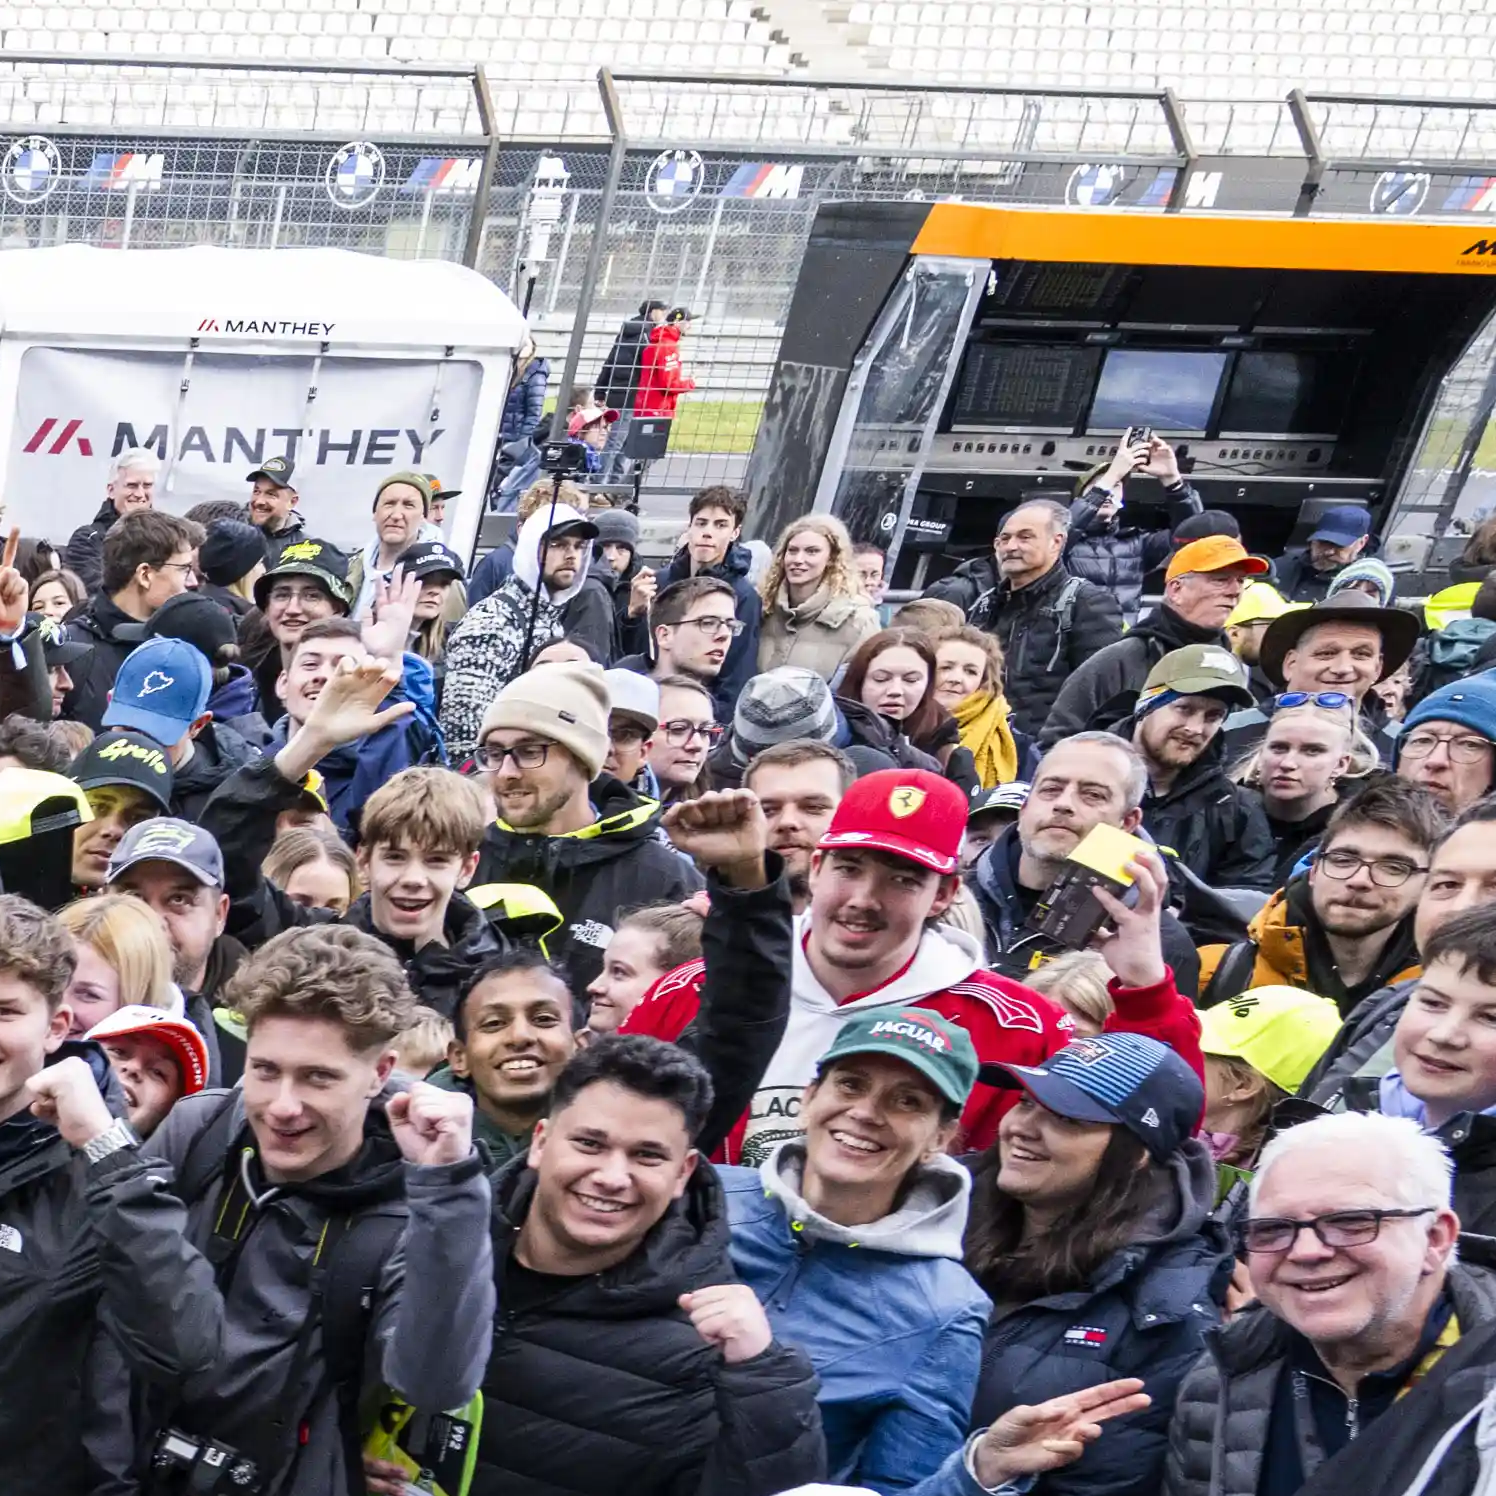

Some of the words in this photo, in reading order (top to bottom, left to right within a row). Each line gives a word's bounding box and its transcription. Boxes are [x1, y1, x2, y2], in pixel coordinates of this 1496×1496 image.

[224, 320, 336, 336] MANTHEY
[110, 422, 446, 467] MANTHEY
[98, 738, 168, 774] Grello
[870, 1019, 945, 1050] JAGUAR
